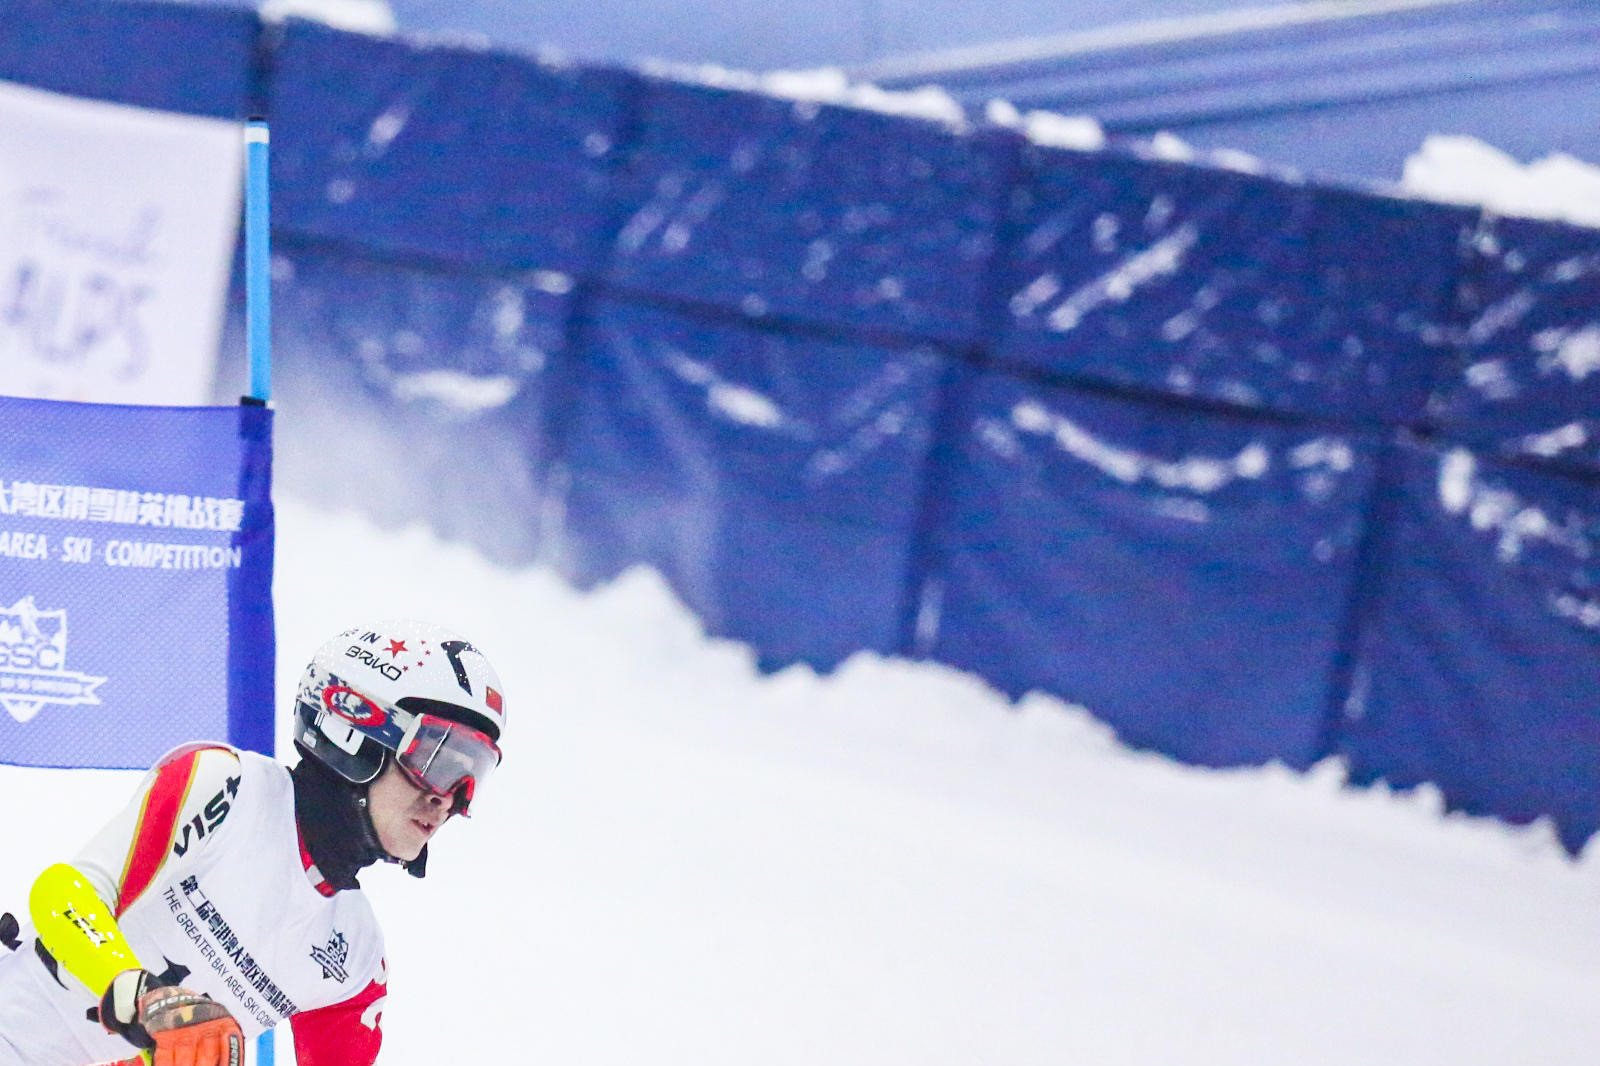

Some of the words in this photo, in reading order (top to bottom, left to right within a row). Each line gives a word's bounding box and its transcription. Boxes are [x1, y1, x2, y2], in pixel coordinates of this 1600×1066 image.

[61, 536, 93, 563] SKI
[105, 540, 242, 570] COMPETITION
[162, 885, 178, 913] THE
[176, 912, 215, 963] GREATER
[211, 959, 228, 980] BAY
[224, 976, 245, 1003] AREA
[243, 995, 258, 1015] SKI
